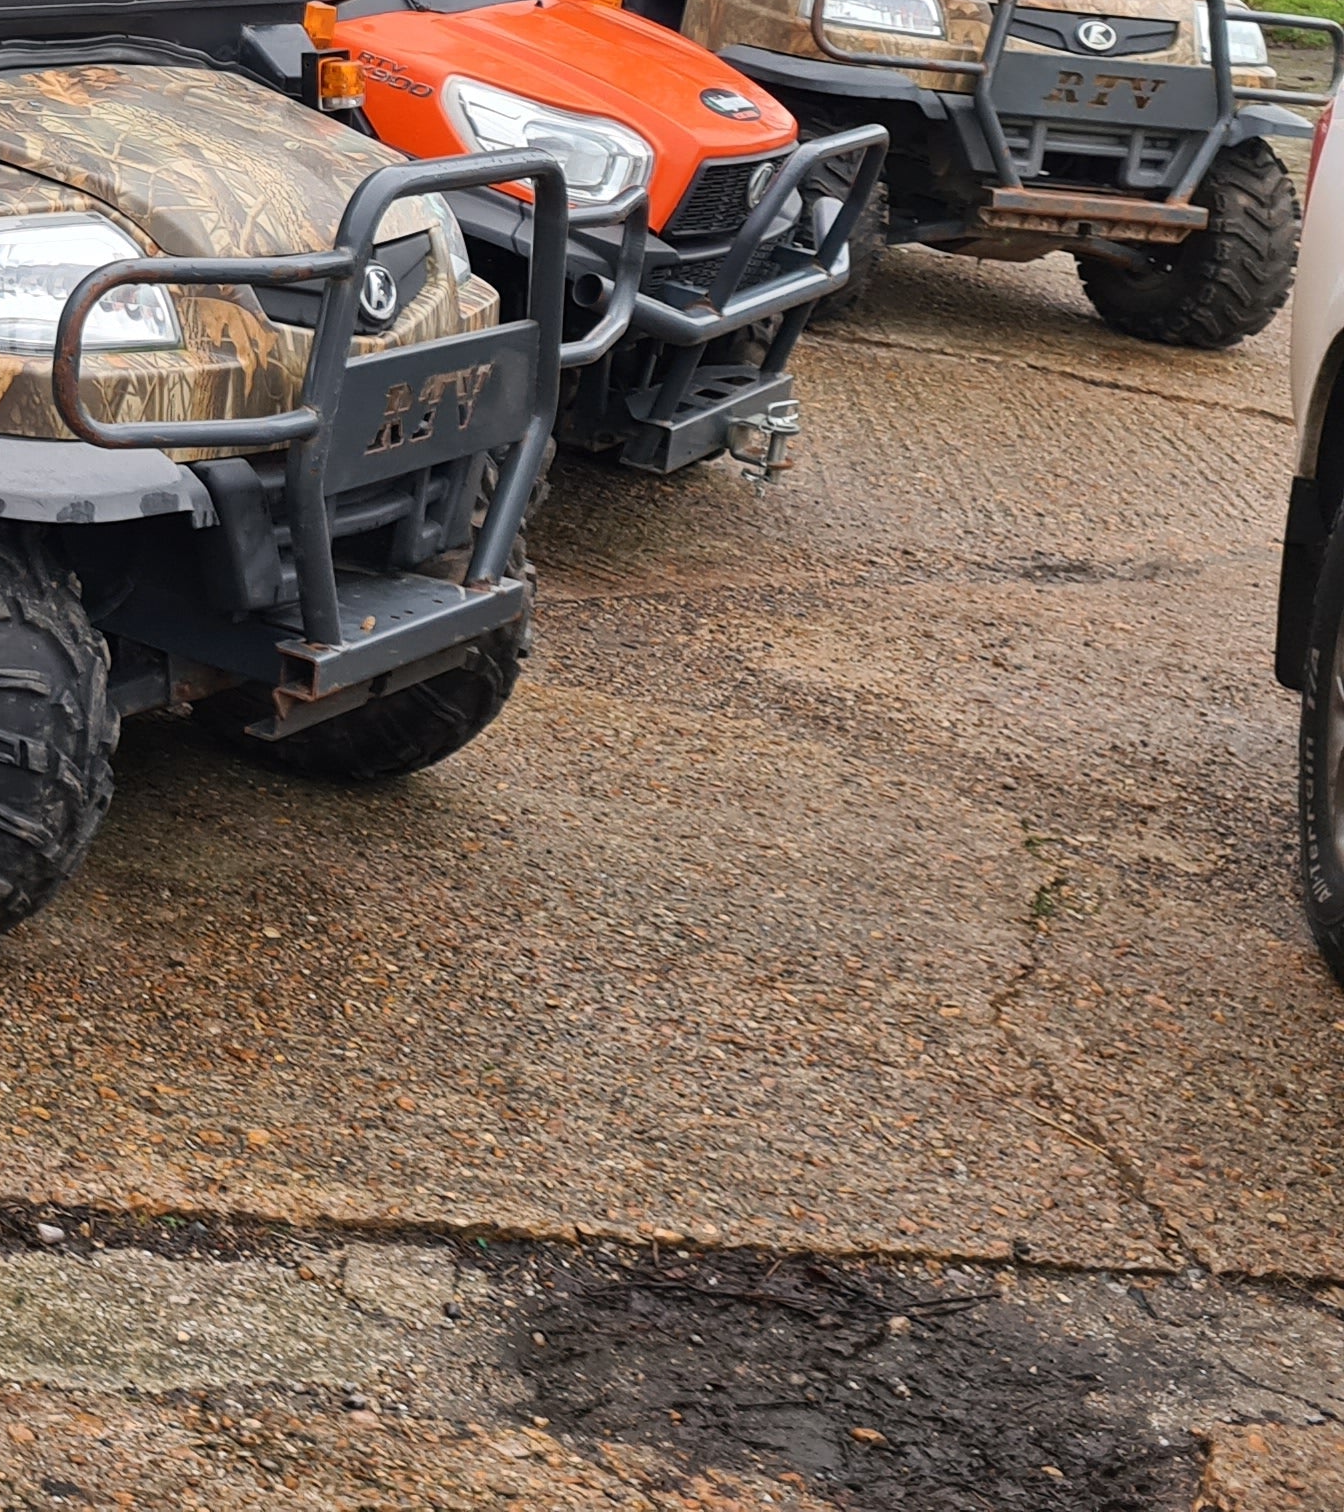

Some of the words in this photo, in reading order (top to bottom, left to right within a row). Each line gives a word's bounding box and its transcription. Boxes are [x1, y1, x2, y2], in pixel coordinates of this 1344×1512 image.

[358, 51, 408, 73] RTV
[1042, 70, 1167, 109] RTV
[365, 361, 494, 455] RTV
